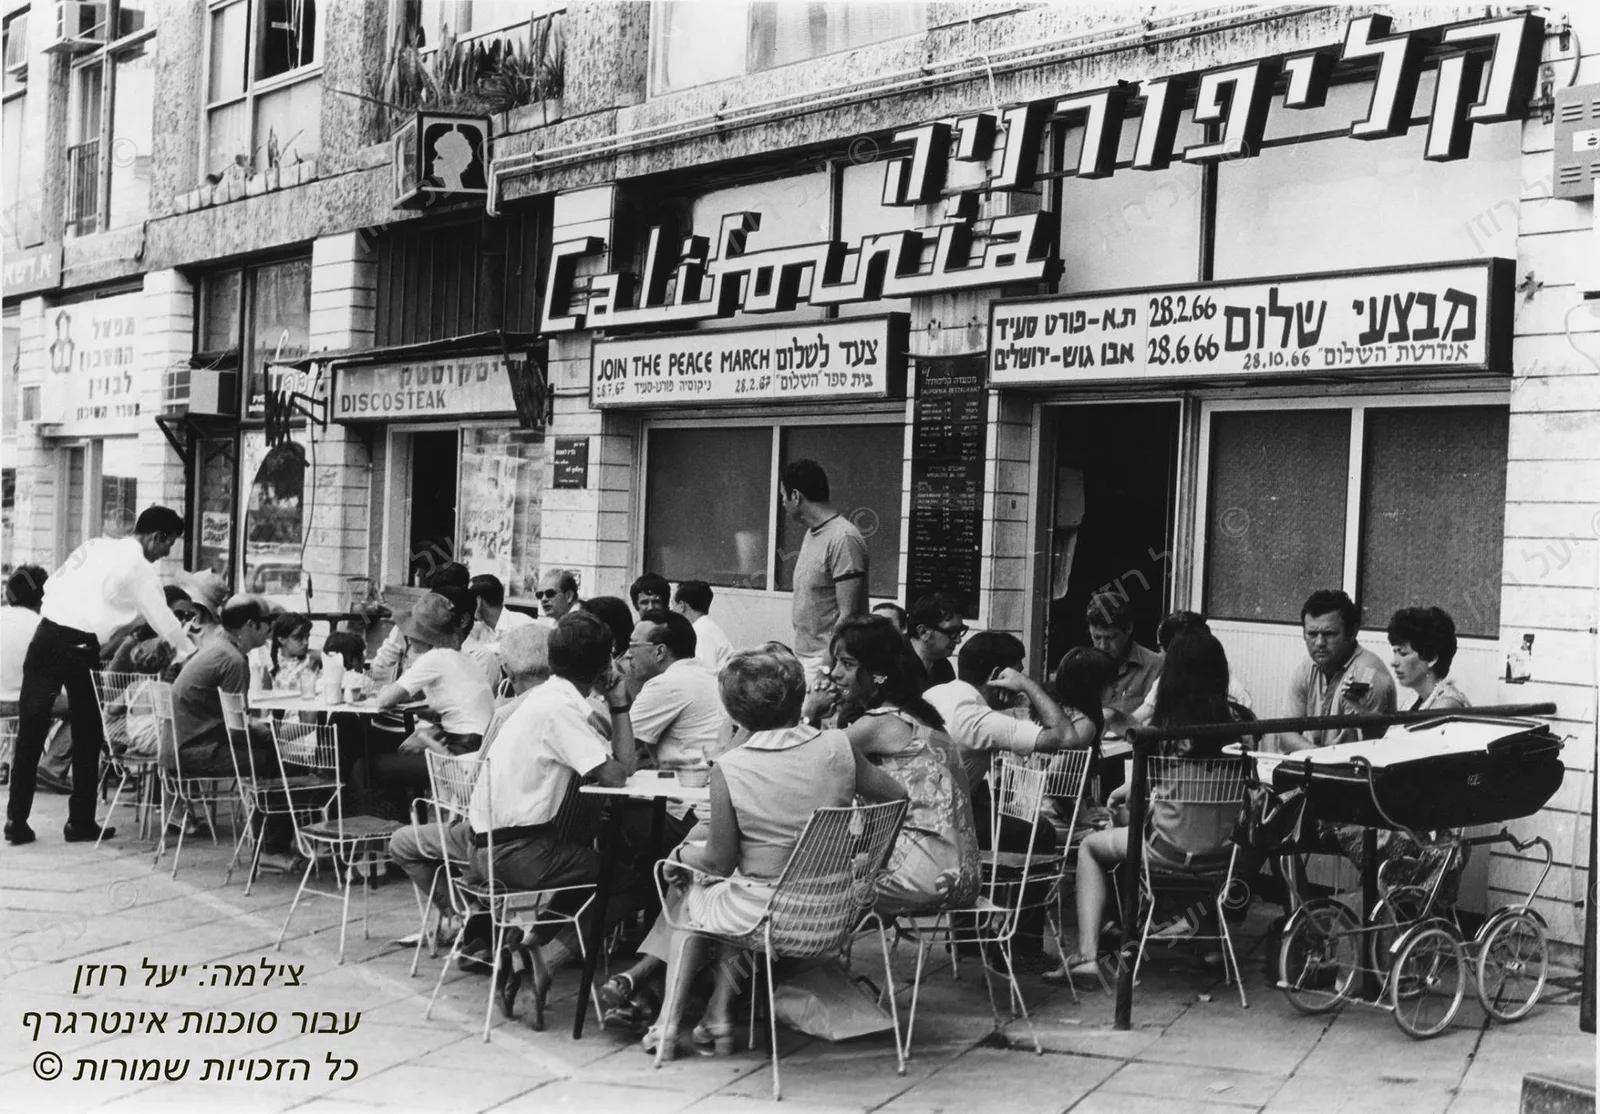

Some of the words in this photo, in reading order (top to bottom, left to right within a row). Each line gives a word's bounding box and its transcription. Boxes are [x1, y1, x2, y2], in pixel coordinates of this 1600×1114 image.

[881, 13, 1541, 207] קליפורניה
[539, 191, 1055, 334] California
[1150, 295, 1217, 327] 28.2.66
[1224, 287, 1327, 351] שלום
[1352, 288, 1477, 346] מבצעי
[996, 316, 1039, 341] סעיד
[776, 333, 830, 371] לשלום
[839, 338, 878, 368] צעד
[1101, 342, 1135, 367] אבו
[1147, 334, 1220, 366] 28.6.66
[1243, 351, 1311, 370] 28.10.66
[1396, 342, 1469, 363] אנדרטת
[597, 357, 627, 381] JOIN
[632, 354, 661, 377] THE
[668, 351, 713, 377] PEACE
[720, 348, 770, 373] MARCH
[679, 380, 712, 394] ניקוסיה
[735, 375, 771, 393] 28.2.67
[824, 372, 847, 388] ספר
[851, 372, 873, 388] בית
[341, 390, 447, 413] DISCOSTEAK
